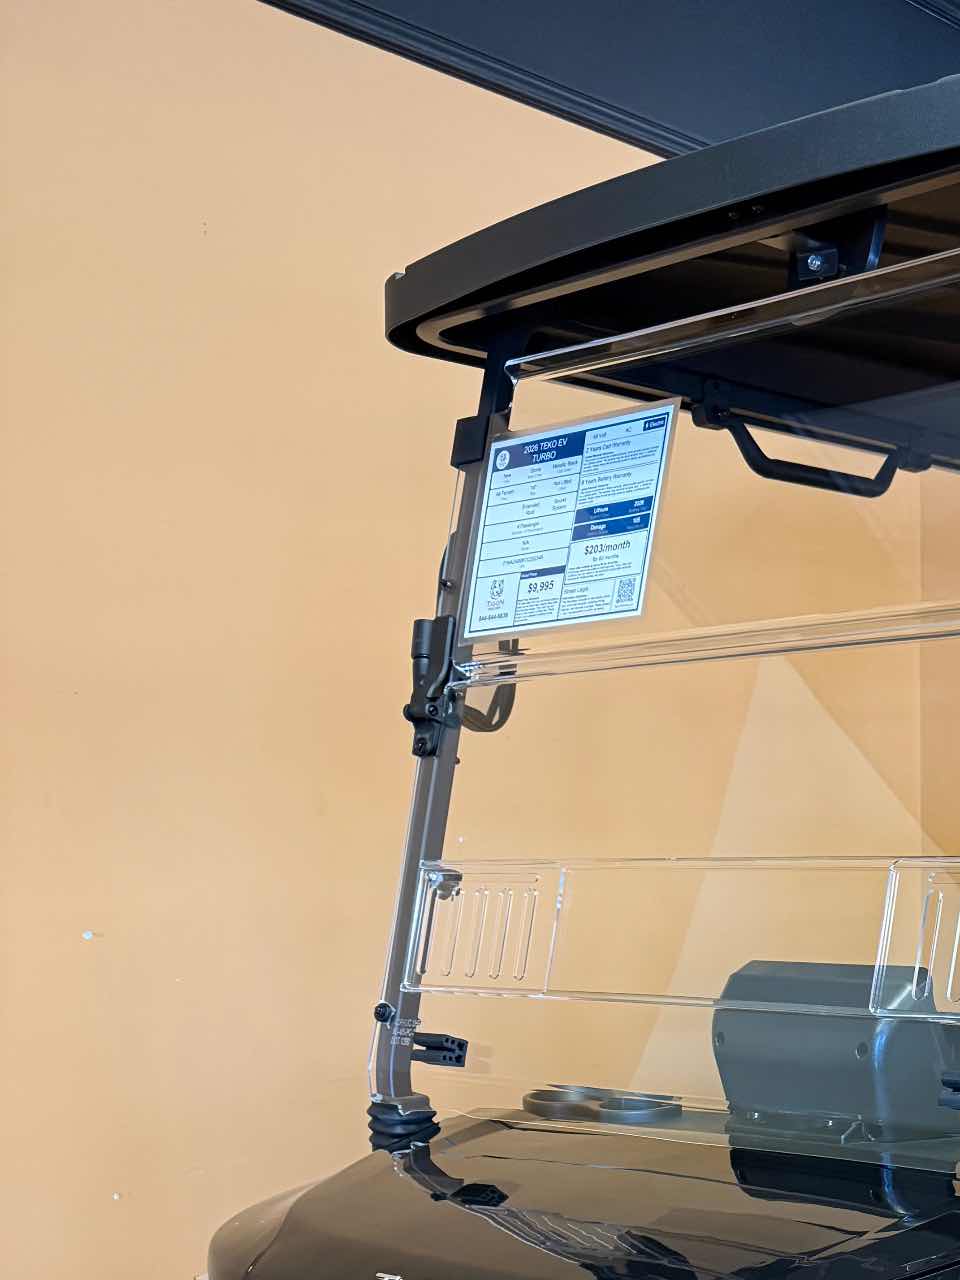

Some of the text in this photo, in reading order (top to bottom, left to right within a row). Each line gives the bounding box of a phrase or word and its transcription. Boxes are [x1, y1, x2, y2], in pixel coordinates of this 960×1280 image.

[523, 437, 568, 454] 2026 TEKO EV
[532, 451, 557, 463] TURBO
[584, 540, 631, 555] $203/month
[528, 580, 554, 593] $9,995
